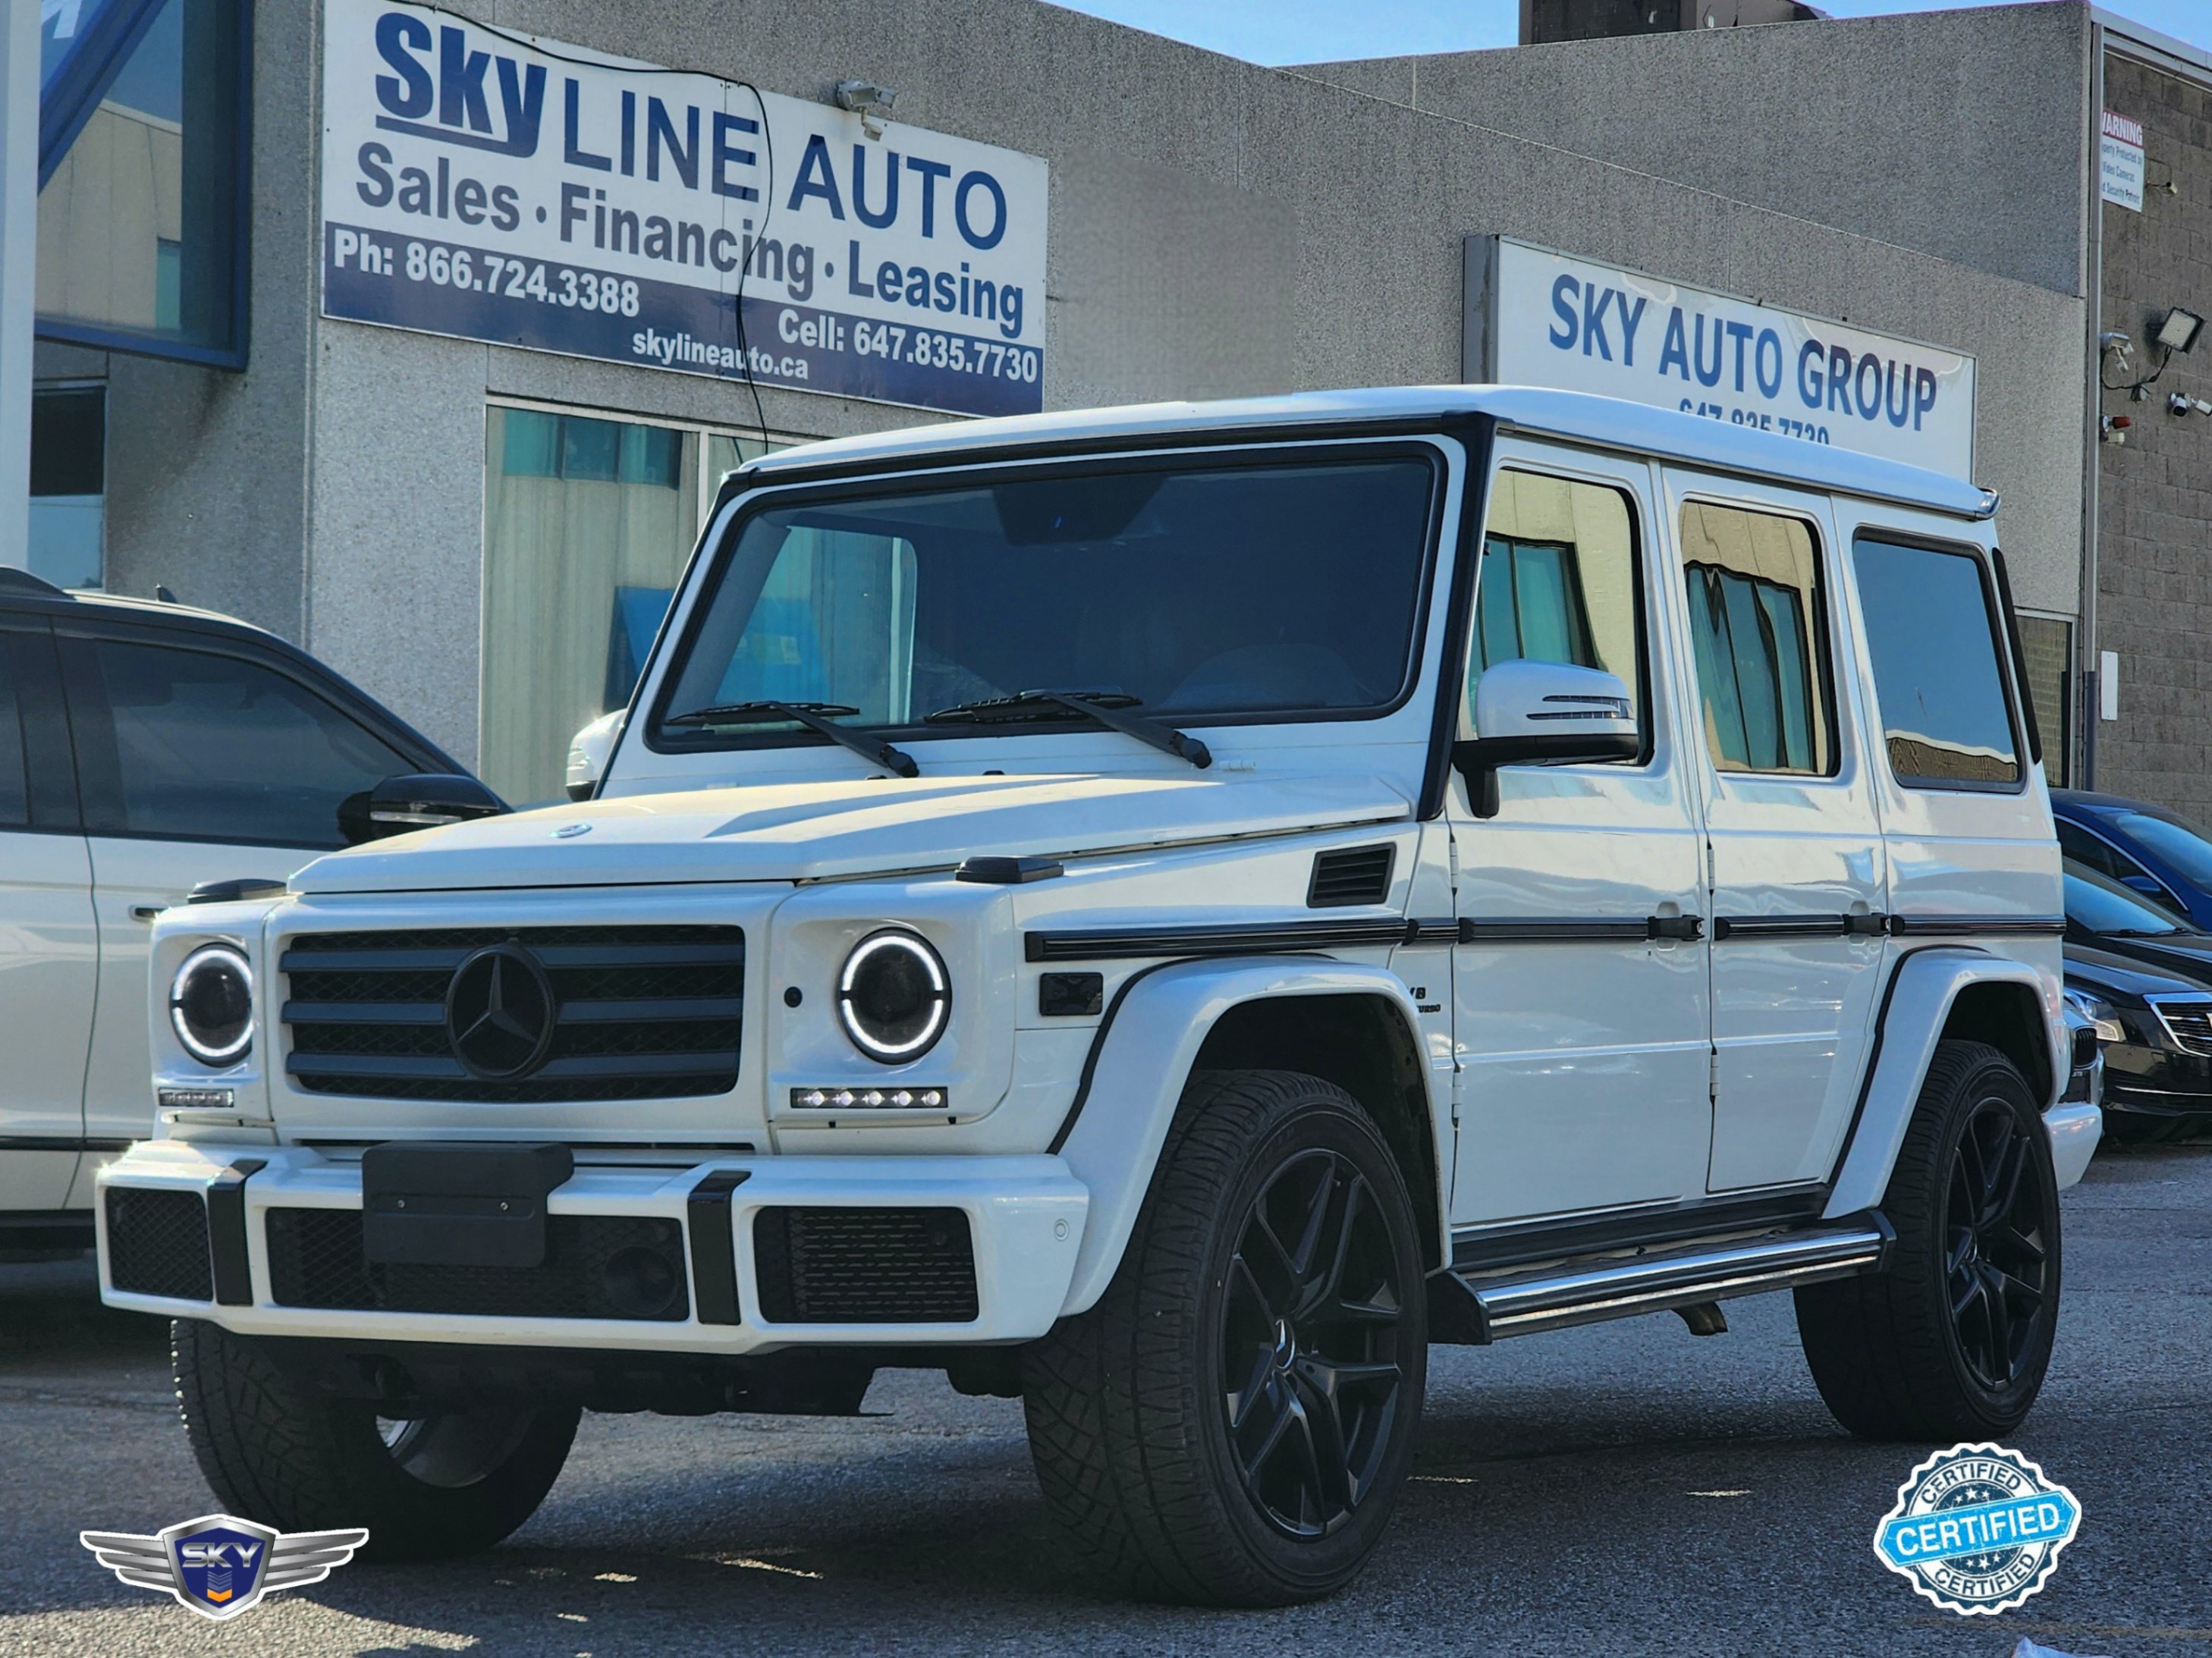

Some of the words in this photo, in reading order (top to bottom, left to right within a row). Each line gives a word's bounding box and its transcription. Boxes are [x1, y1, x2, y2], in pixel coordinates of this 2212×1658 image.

[356, 141, 520, 232] Sales
[560, 181, 814, 302] Financing
[848, 240, 1023, 338] Leasing
[787, 133, 1007, 250] AUTO
[334, 229, 393, 276] Ph:
[405, 243, 640, 318] 866.724.3388
[632, 328, 809, 379] skylineauto.ca
[778, 309, 844, 351] Cell:
[853, 322, 1038, 383] 647.835.7730
[1549, 274, 1647, 366] SKY
[1659, 306, 1783, 399] AUTO
[1798, 338, 1937, 432] GROUP
